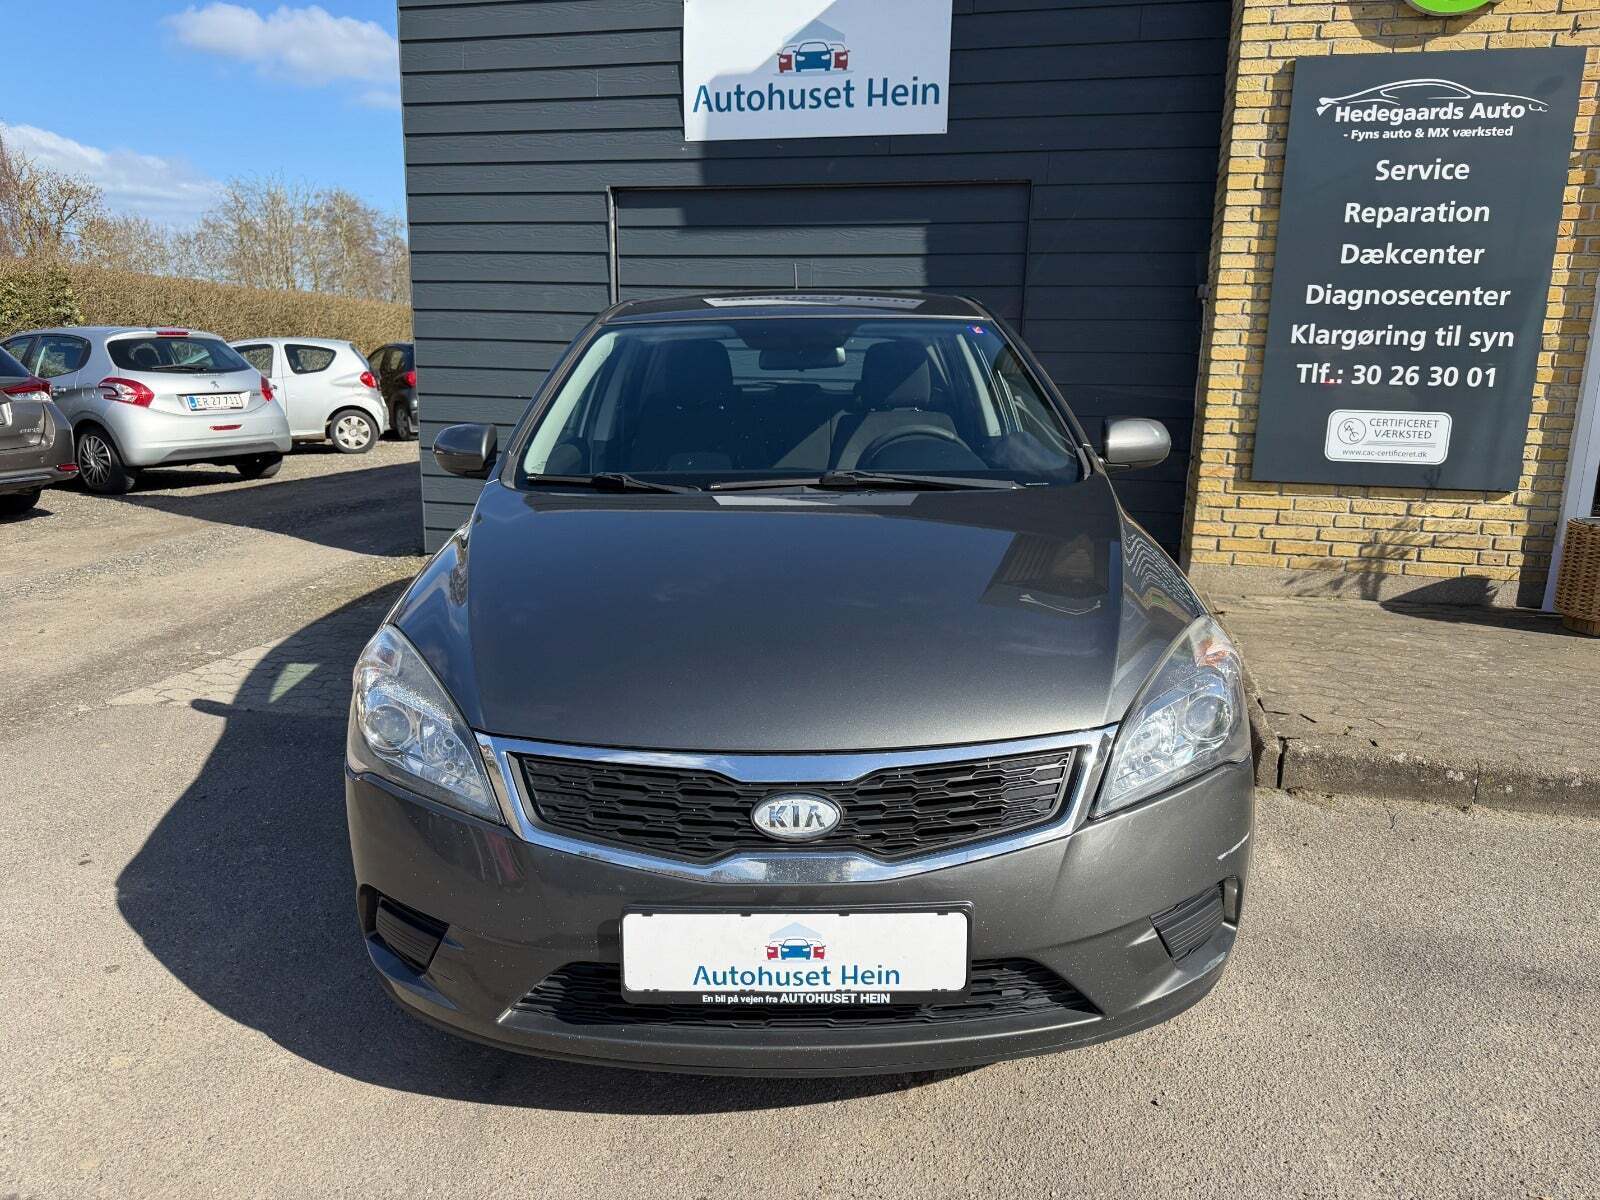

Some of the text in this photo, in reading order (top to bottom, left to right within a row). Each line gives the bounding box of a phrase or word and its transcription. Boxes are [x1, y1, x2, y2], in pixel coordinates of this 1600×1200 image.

[693, 76, 940, 113] Autohuset Hein
[1335, 102, 1526, 126] Hedegaards Auto
[1351, 130, 1379, 142] Fyns
[1382, 128, 1412, 140] auto
[1414, 128, 1425, 139] &
[1427, 127, 1449, 138] MX
[1452, 125, 1514, 138] værksted
[1375, 158, 1470, 181] Service
[1344, 201, 1490, 228] Reparation
[1340, 243, 1485, 265] Dækcenter
[1305, 284, 1511, 310] Diagnosecenter
[1290, 324, 1515, 351] Klargøring til syn
[1351, 364, 1381, 385] 30
[1389, 365, 1420, 386] 26
[1427, 366, 1459, 386] 30
[1466, 366, 1496, 387] 01
[1369, 418, 1439, 429] CERTIFICERET
[1374, 429, 1432, 440] VÆRKSTED
[1342, 449, 1428, 458] www.cac-certificeret.dk
[768, 804, 826, 828] KIA
[692, 964, 900, 987] Autohuset Hein
[702, 993, 891, 1005] En bil på vejen fra AUTOHUSET HEIN
